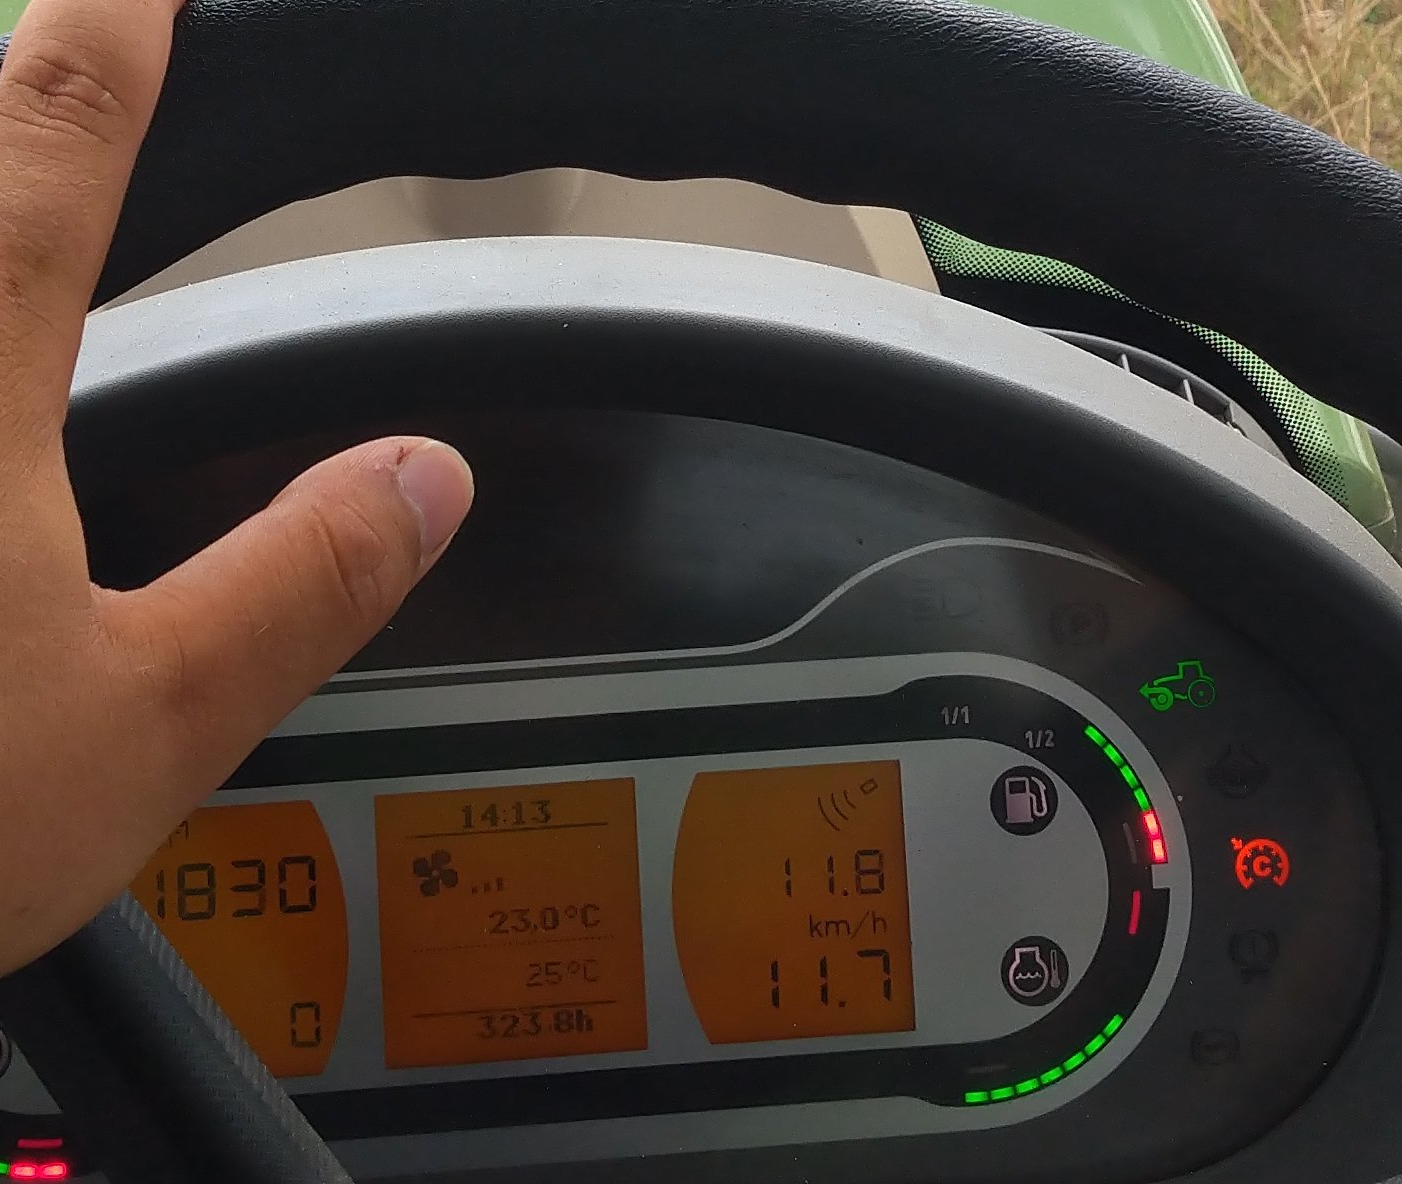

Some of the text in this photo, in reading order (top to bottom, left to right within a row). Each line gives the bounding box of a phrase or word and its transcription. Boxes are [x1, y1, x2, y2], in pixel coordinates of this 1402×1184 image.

[940, 704, 971, 727] 1/1
[1024, 728, 1056, 750] 1/2
[460, 798, 553, 829] 14:13
[155, 854, 318, 921] 1830
[783, 848, 886, 899] 11.8
[807, 909, 889, 940] km/h
[769, 948, 893, 1009] 11.7
[290, 1002, 321, 1049] 0
